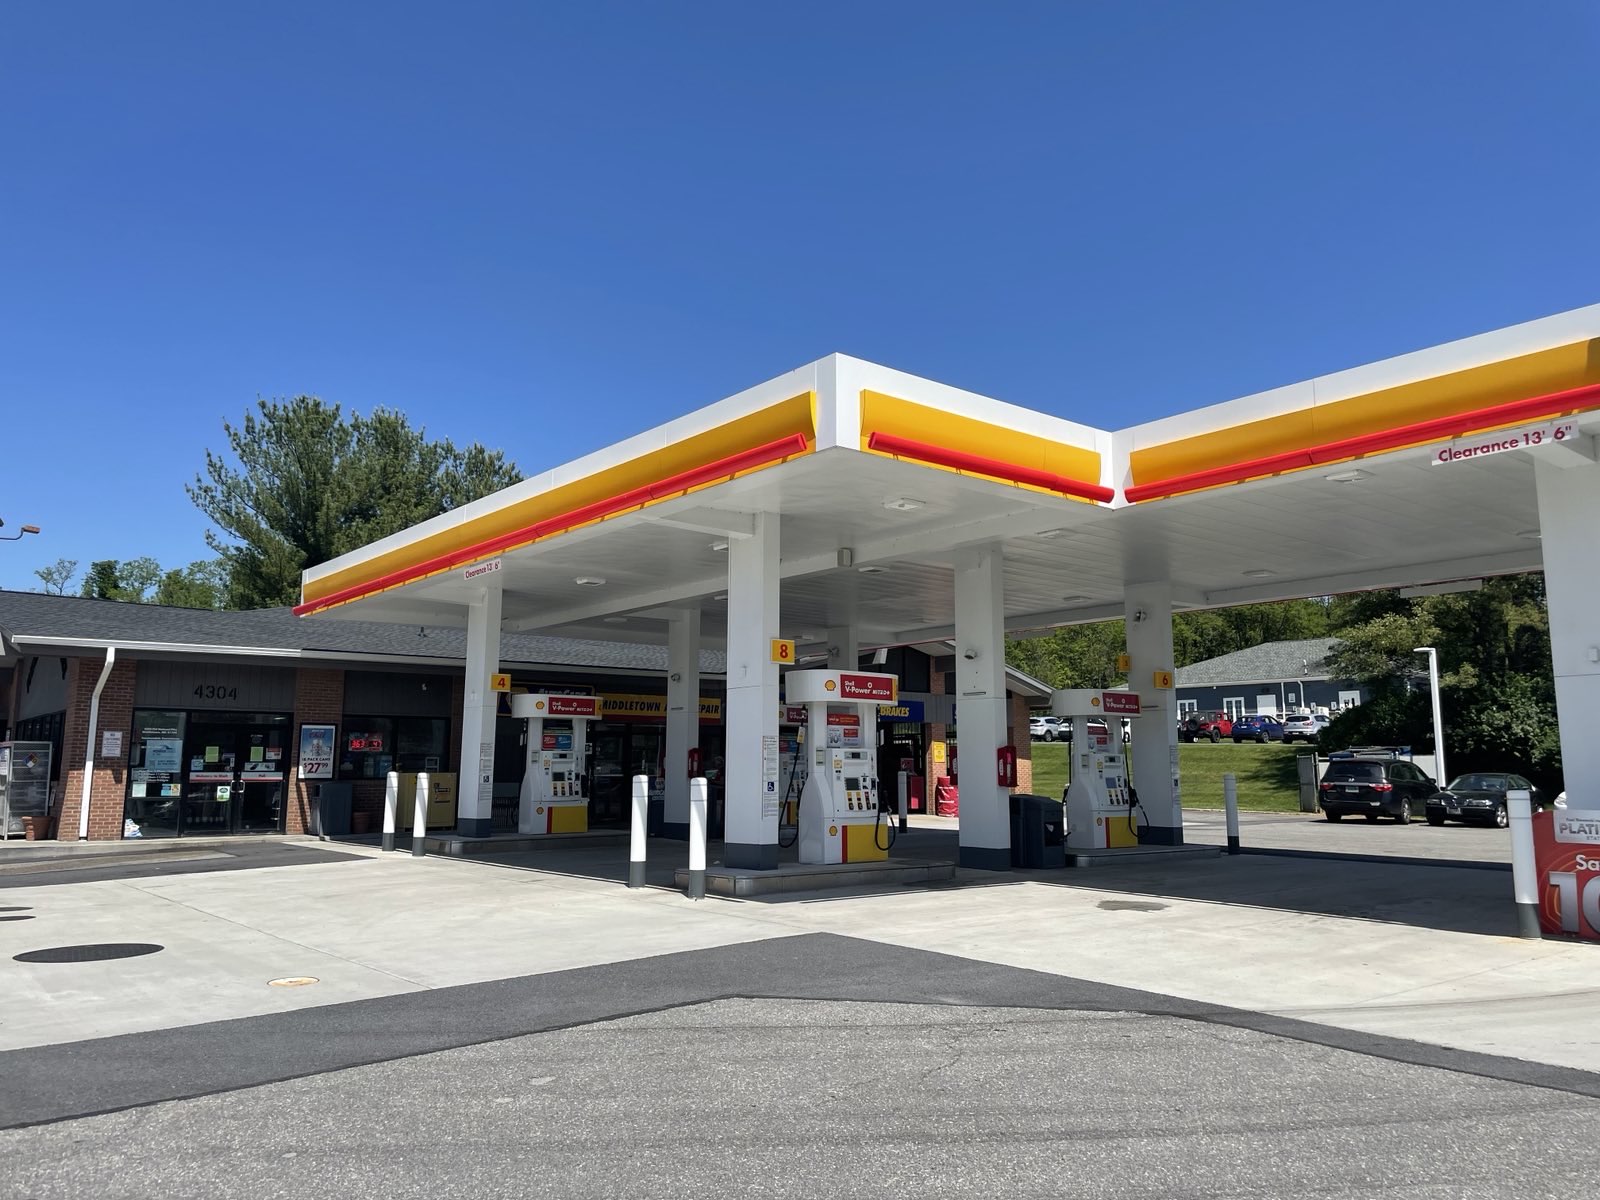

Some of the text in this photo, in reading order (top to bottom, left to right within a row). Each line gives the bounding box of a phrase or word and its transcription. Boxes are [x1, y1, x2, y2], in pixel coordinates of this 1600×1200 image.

[1438, 425, 1572, 462] Clearance 13' 6"
[465, 566, 487, 579] Clearance
[780, 644, 789, 658] 8
[498, 677, 506, 688] 4
[1162, 674, 1169, 686] 6
[193, 684, 237, 700] 4304
[845, 685, 871, 694] V-Power
[602, 699, 661, 711] MIDDLETOWN
[880, 706, 910, 718] BRAKES
[1575, 854, 1600, 871] Sa
